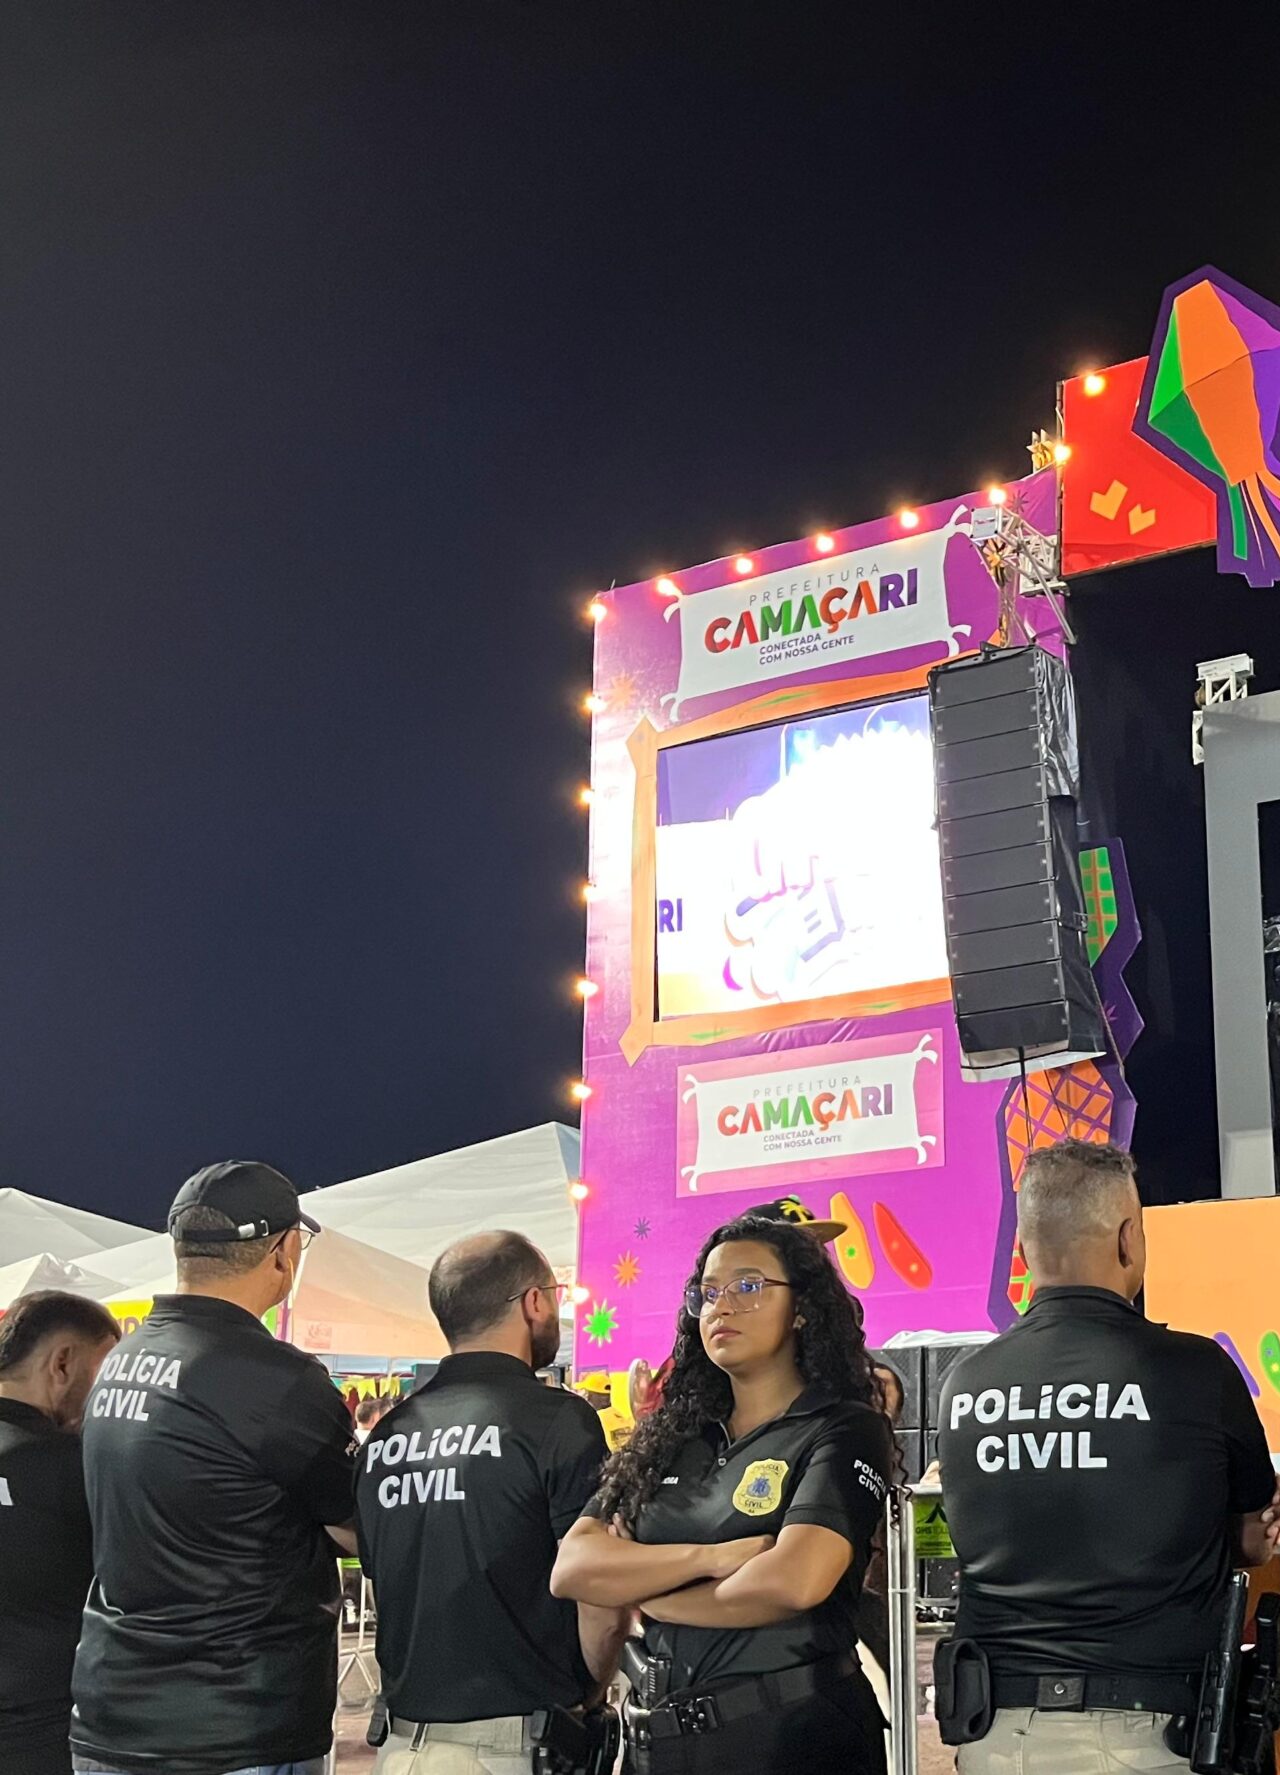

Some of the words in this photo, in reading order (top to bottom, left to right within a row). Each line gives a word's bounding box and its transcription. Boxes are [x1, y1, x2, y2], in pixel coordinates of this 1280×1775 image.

[749, 563, 881, 606] PREFEITURA
[704, 568, 918, 654] CAMAÇARI
[759, 632, 822, 655] CONECTADA
[759, 653, 782, 665] COM
[784, 643, 819, 660] NOSSA
[821, 634, 855, 650] GENTE
[753, 1075, 862, 1098] PREFEITURA
[717, 1083, 893, 1136] CAMAÇARI
[763, 1129, 815, 1143] CONECTADA
[763, 1141, 782, 1151] COM
[784, 1138, 813, 1150] NOSSA
[815, 1134, 842, 1145] GENTE
[92, 1388, 149, 1421] CIVIL
[951, 1383, 1150, 1430] POLÍCIA
[976, 1431, 1107, 1472] CIVIL
[378, 1467, 466, 1509] CIVIL
[859, 1474, 880, 1500] CIVIL
